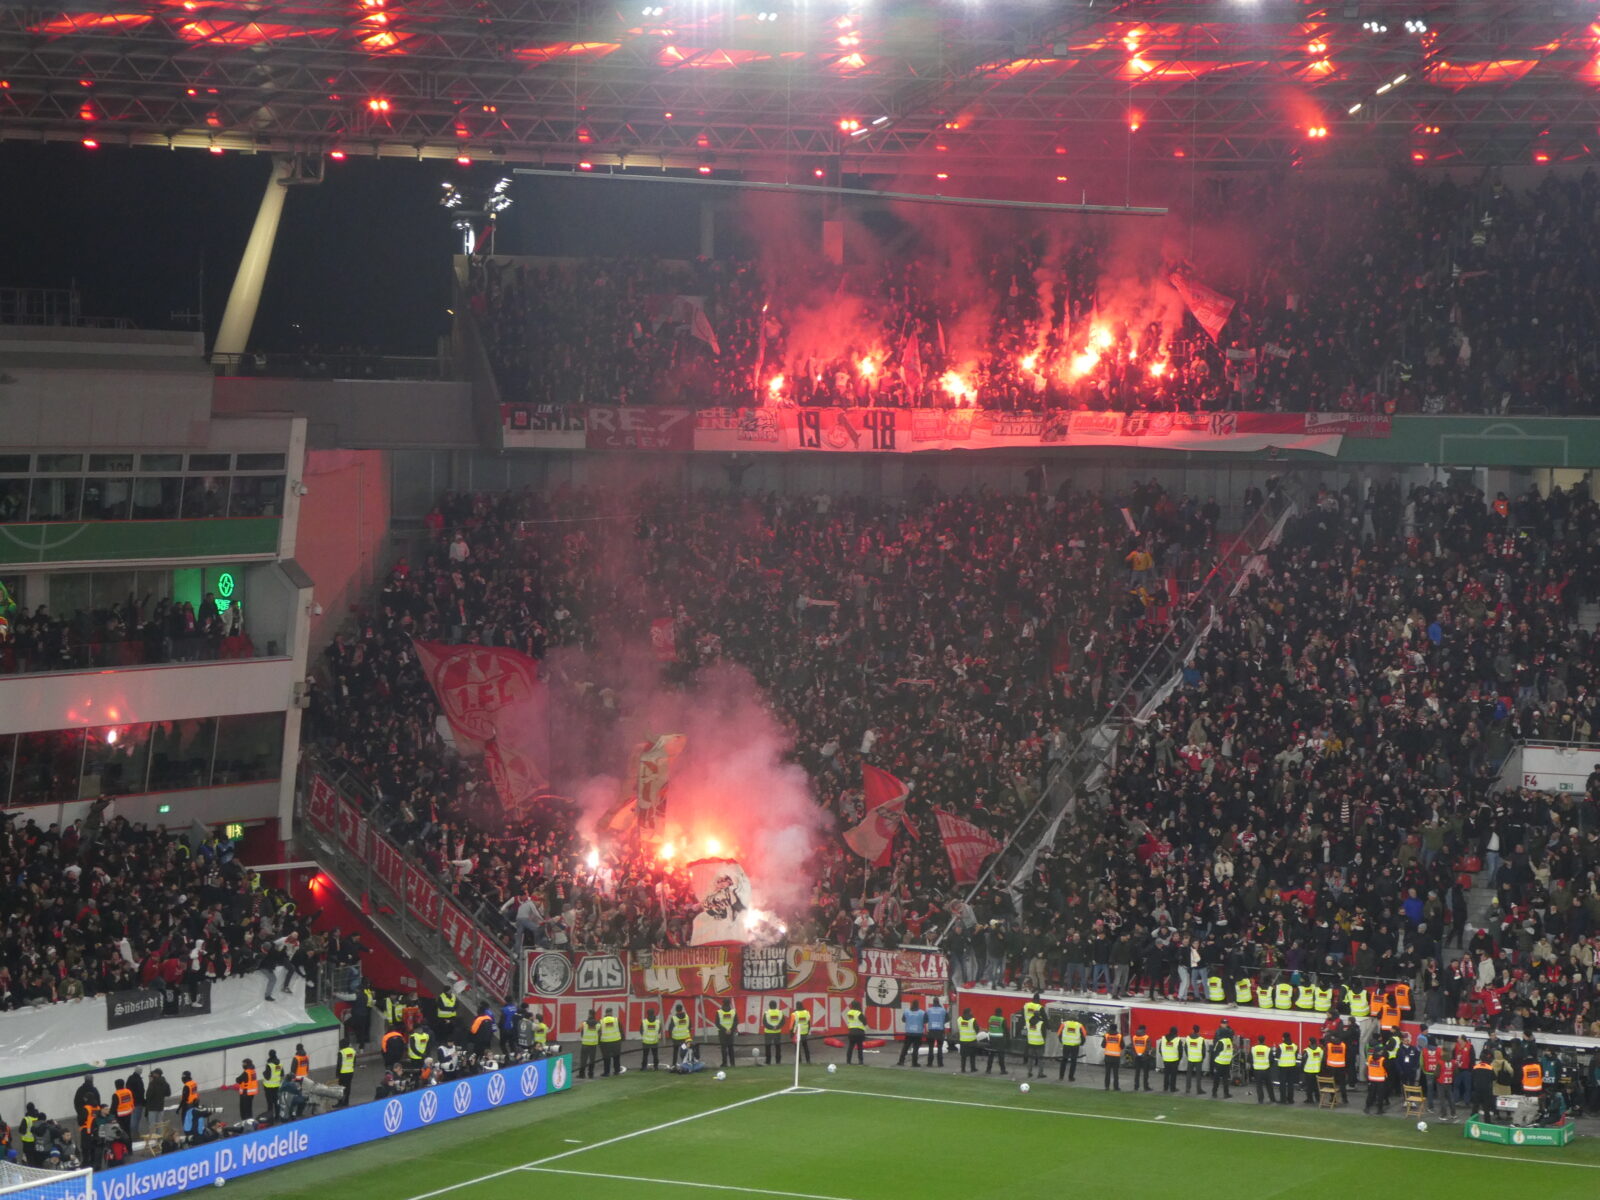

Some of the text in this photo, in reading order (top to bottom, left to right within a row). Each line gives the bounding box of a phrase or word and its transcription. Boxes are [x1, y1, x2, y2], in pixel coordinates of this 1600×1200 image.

[606, 435, 671, 447] CREW
[1523, 774, 1537, 787] F4
[578, 957, 624, 989] CNS
[743, 960, 785, 977] STADT
[858, 950, 949, 978] SYNKAT
[114, 996, 158, 1016] Südstadt
[102, 1129, 308, 1200] Volkswagen ID. Modelle
